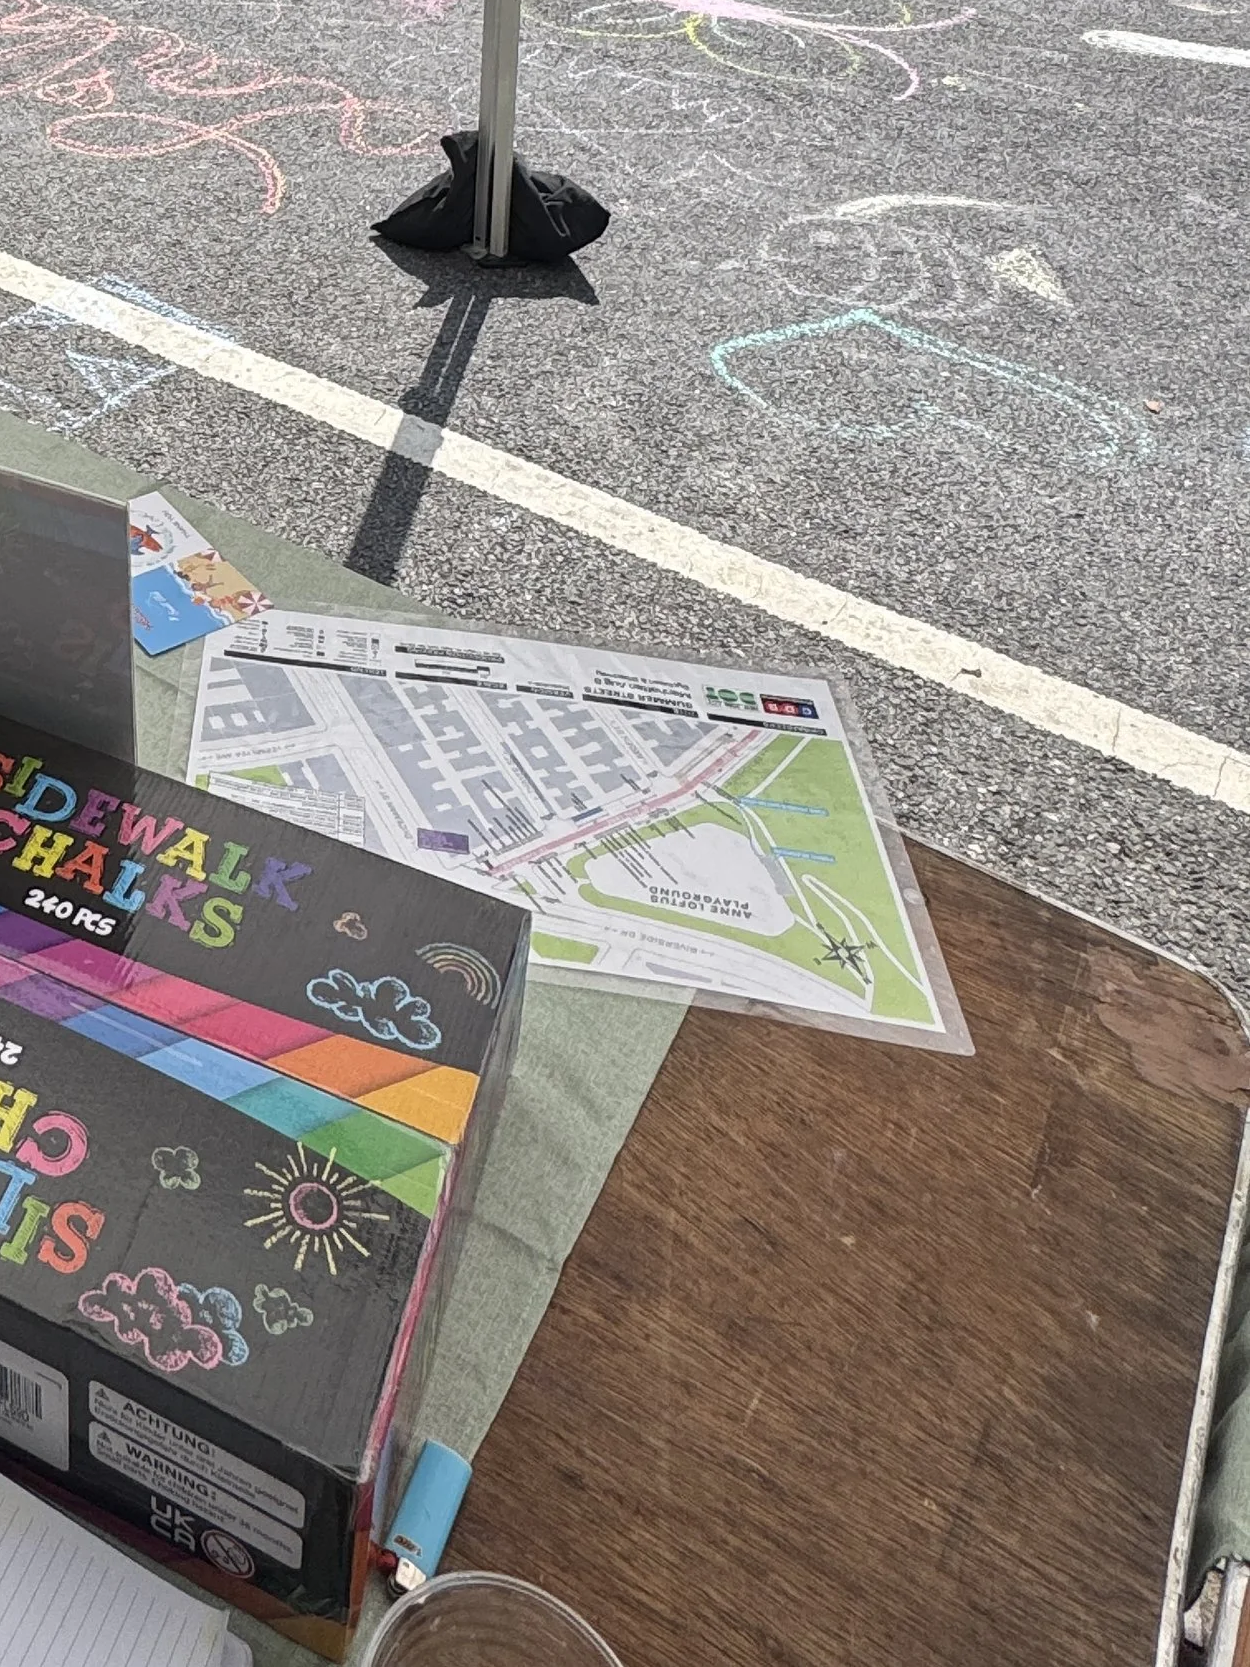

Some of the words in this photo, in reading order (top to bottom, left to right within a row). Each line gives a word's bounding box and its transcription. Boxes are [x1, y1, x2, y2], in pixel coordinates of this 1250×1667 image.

[583, 685, 635, 701] STREETS
[637, 692, 694, 710] SUMMER
[647, 885, 750, 911] PLAYGROUND
[649, 894, 704, 912] LOFTUS
[22, 887, 76, 922] 240
[73, 907, 117, 937] PCS
[710, 904, 753, 920] ANNE
